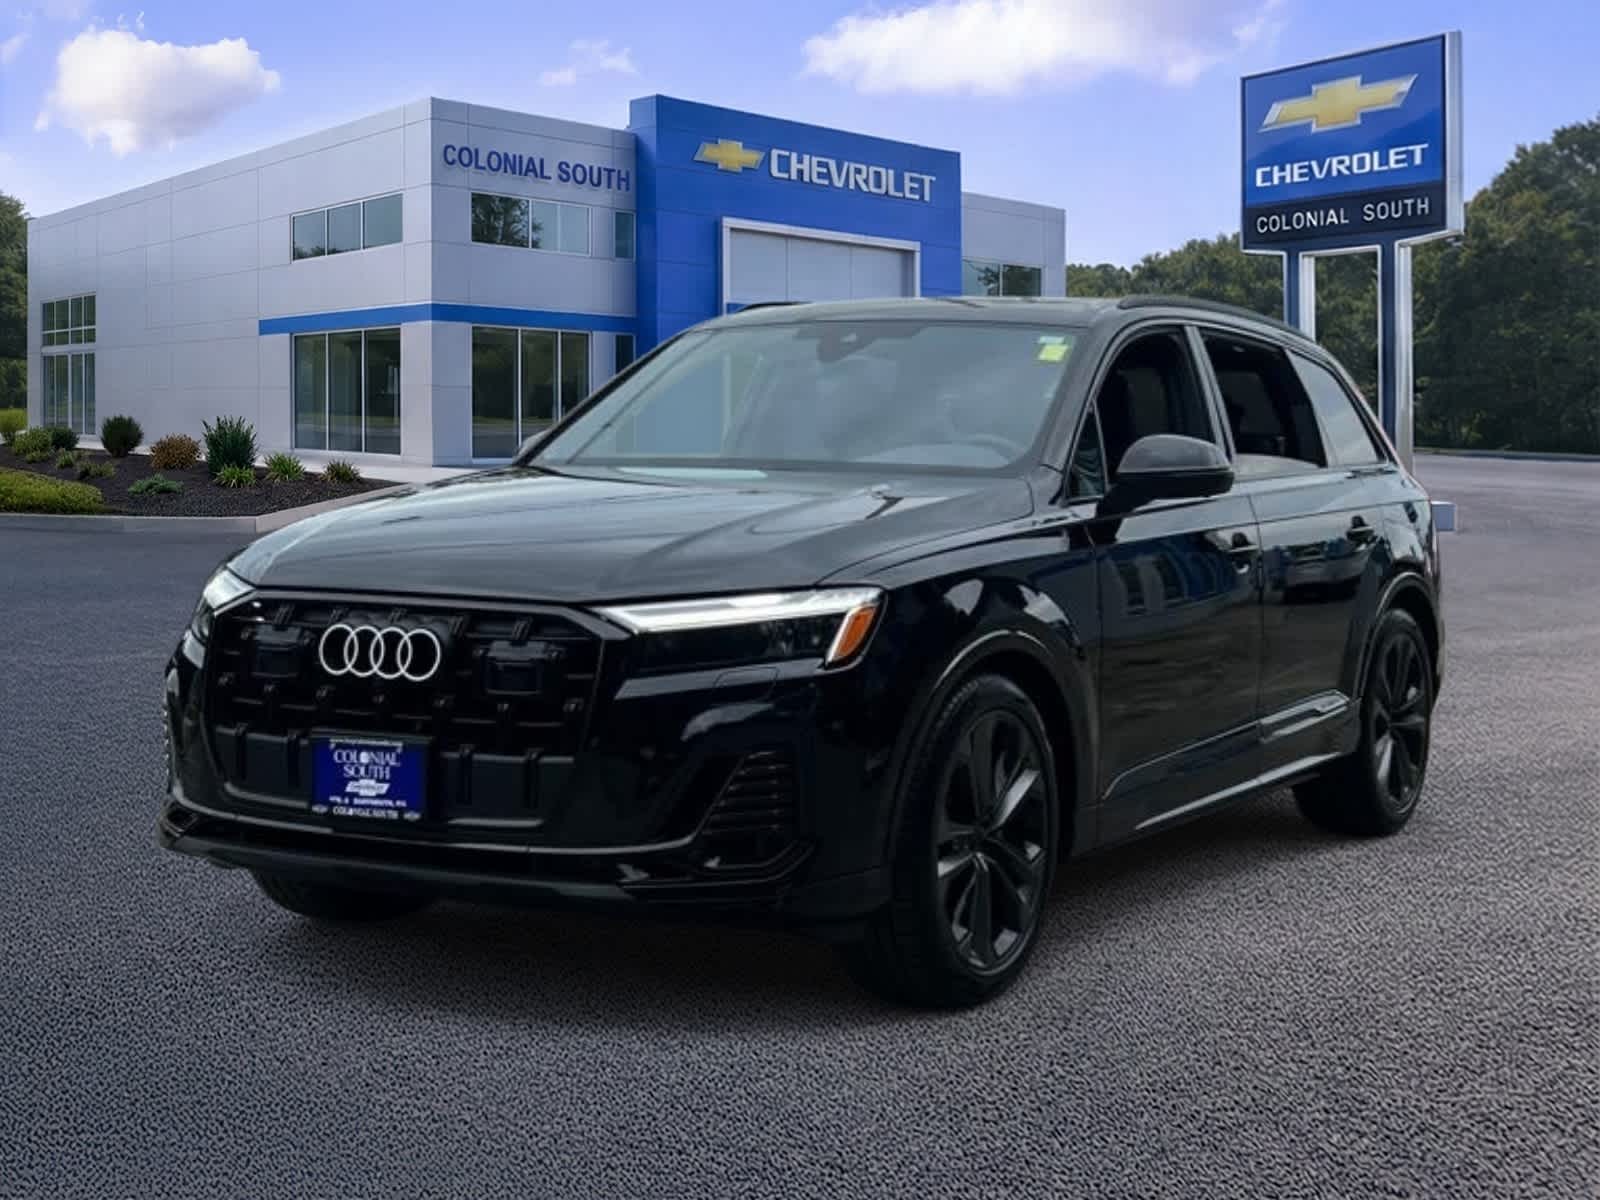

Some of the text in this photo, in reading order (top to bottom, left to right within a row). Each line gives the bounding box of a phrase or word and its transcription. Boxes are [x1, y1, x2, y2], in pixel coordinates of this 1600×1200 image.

[443, 144, 631, 192] COLONIAL SOUTH
[769, 148, 937, 203] CHEVROLET
[1255, 143, 1429, 188] CHEVROLET
[1256, 197, 1430, 234] COLONIAL SOUTH
[333, 749, 401, 767] COLONIAL
[343, 764, 391, 780] SOUTH
